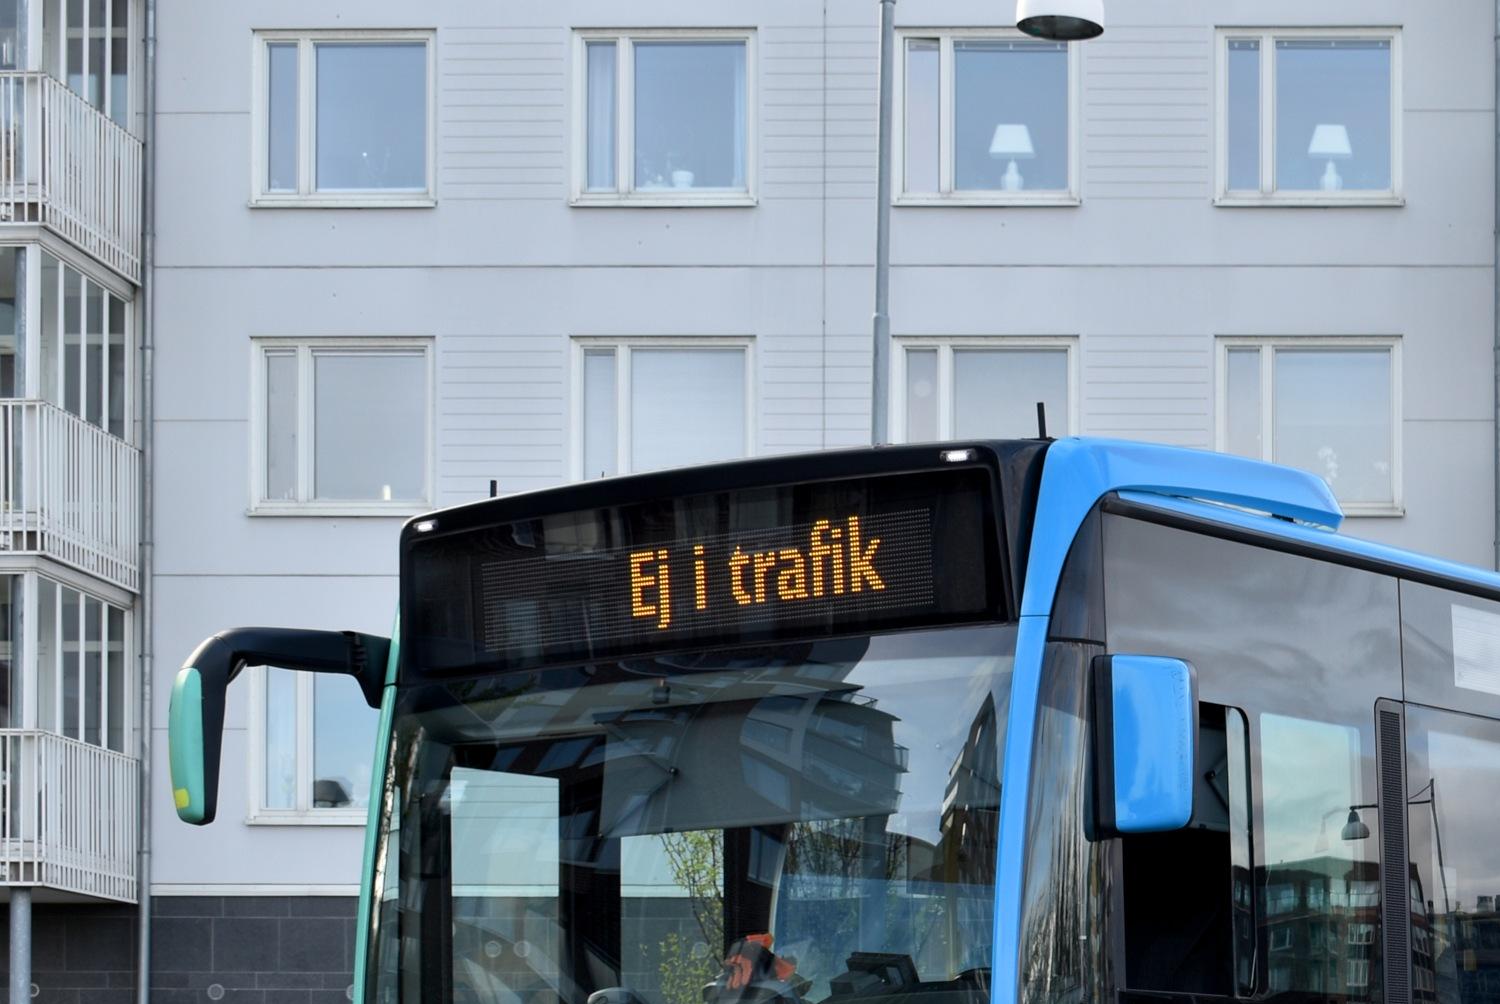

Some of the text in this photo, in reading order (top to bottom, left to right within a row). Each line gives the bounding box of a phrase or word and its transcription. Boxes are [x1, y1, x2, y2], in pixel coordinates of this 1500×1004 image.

[630, 516, 885, 628] Ej i trafik
